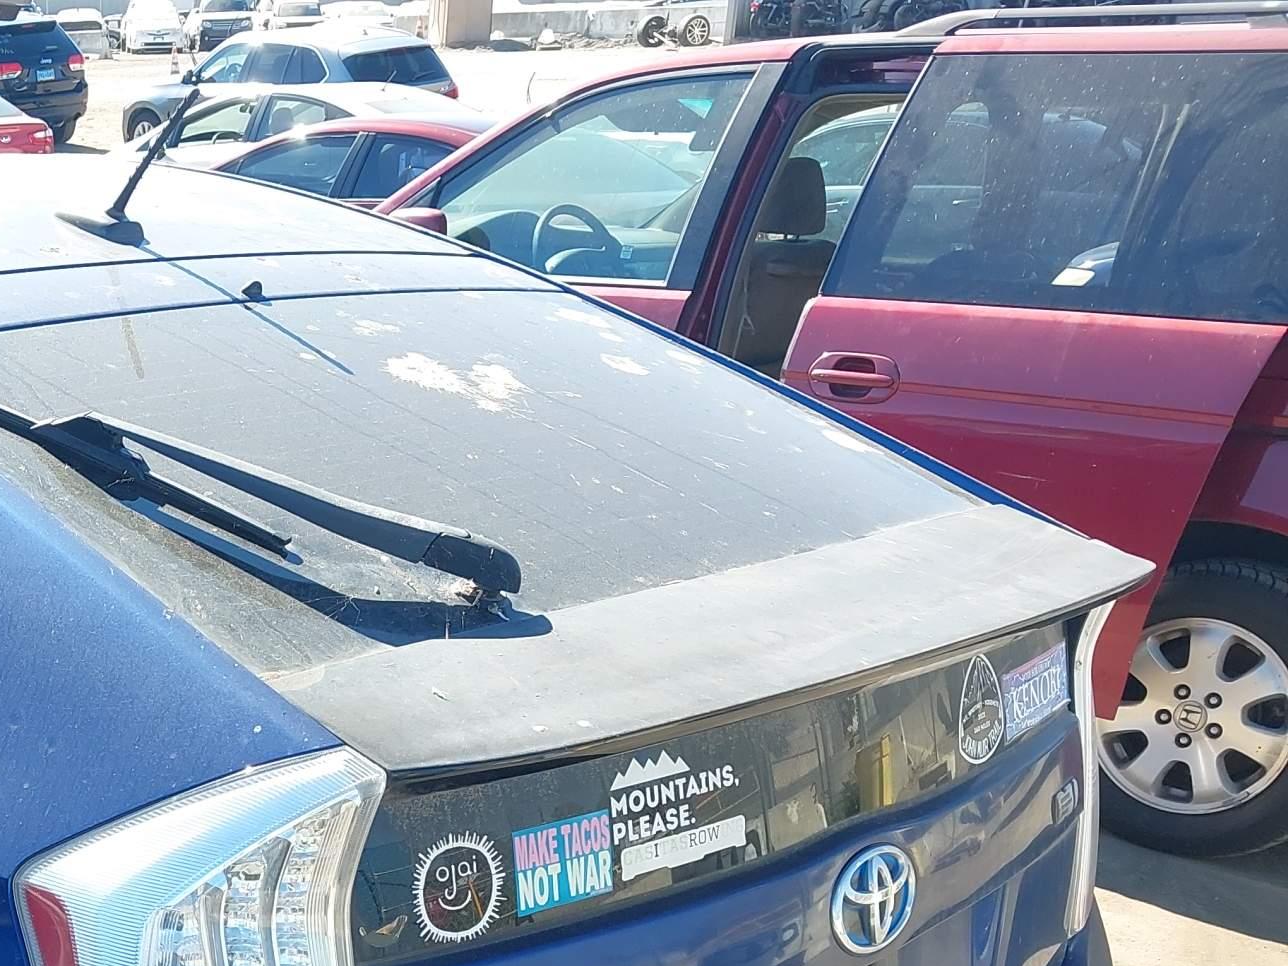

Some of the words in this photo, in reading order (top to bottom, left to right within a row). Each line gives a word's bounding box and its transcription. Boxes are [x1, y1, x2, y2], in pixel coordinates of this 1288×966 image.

[610, 764, 740, 818] MOUNTAINS,
[514, 828, 560, 872] MAKE
[561, 814, 611, 859] TACOS
[613, 804, 697, 846] PLEASE.
[518, 862, 561, 911] NOT
[566, 850, 612, 897] WAR
